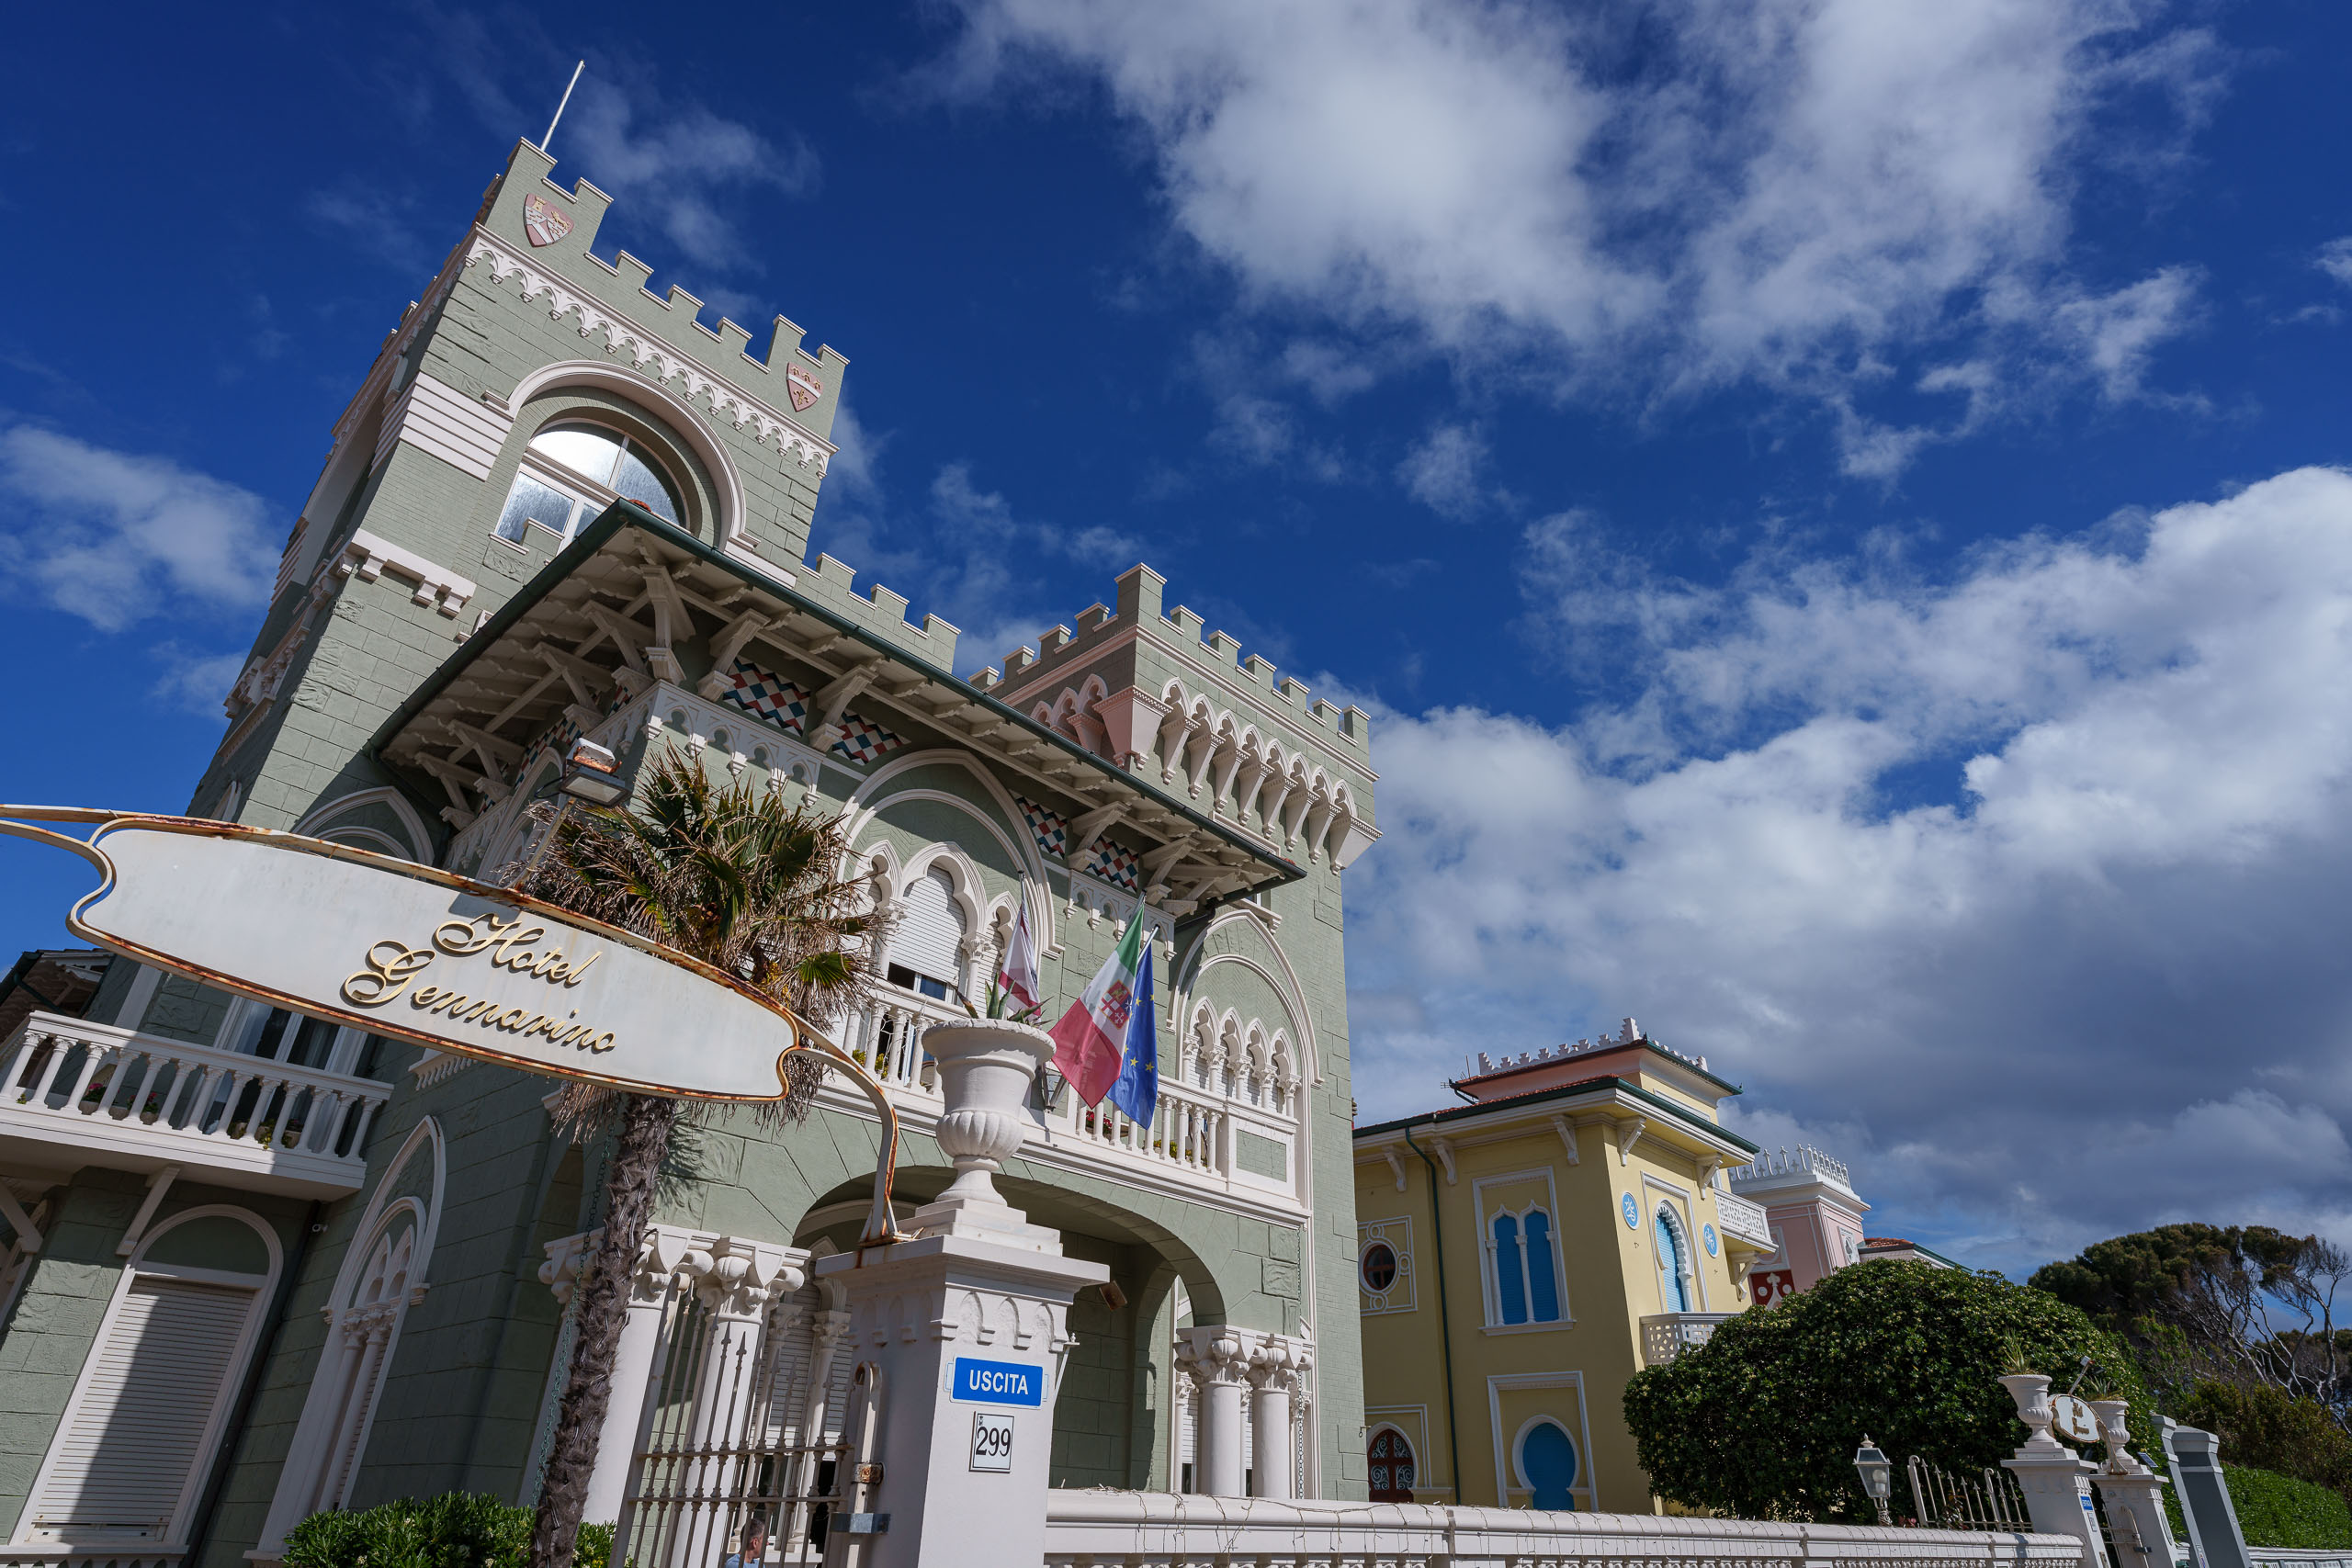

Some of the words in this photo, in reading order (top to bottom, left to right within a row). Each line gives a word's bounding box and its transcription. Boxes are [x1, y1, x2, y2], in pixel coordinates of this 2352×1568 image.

[434, 912, 603, 986] Hotel
[343, 940, 617, 1053] Gennarino
[969, 1370, 1029, 1395] USCITA
[976, 1427, 1011, 1457] 299
